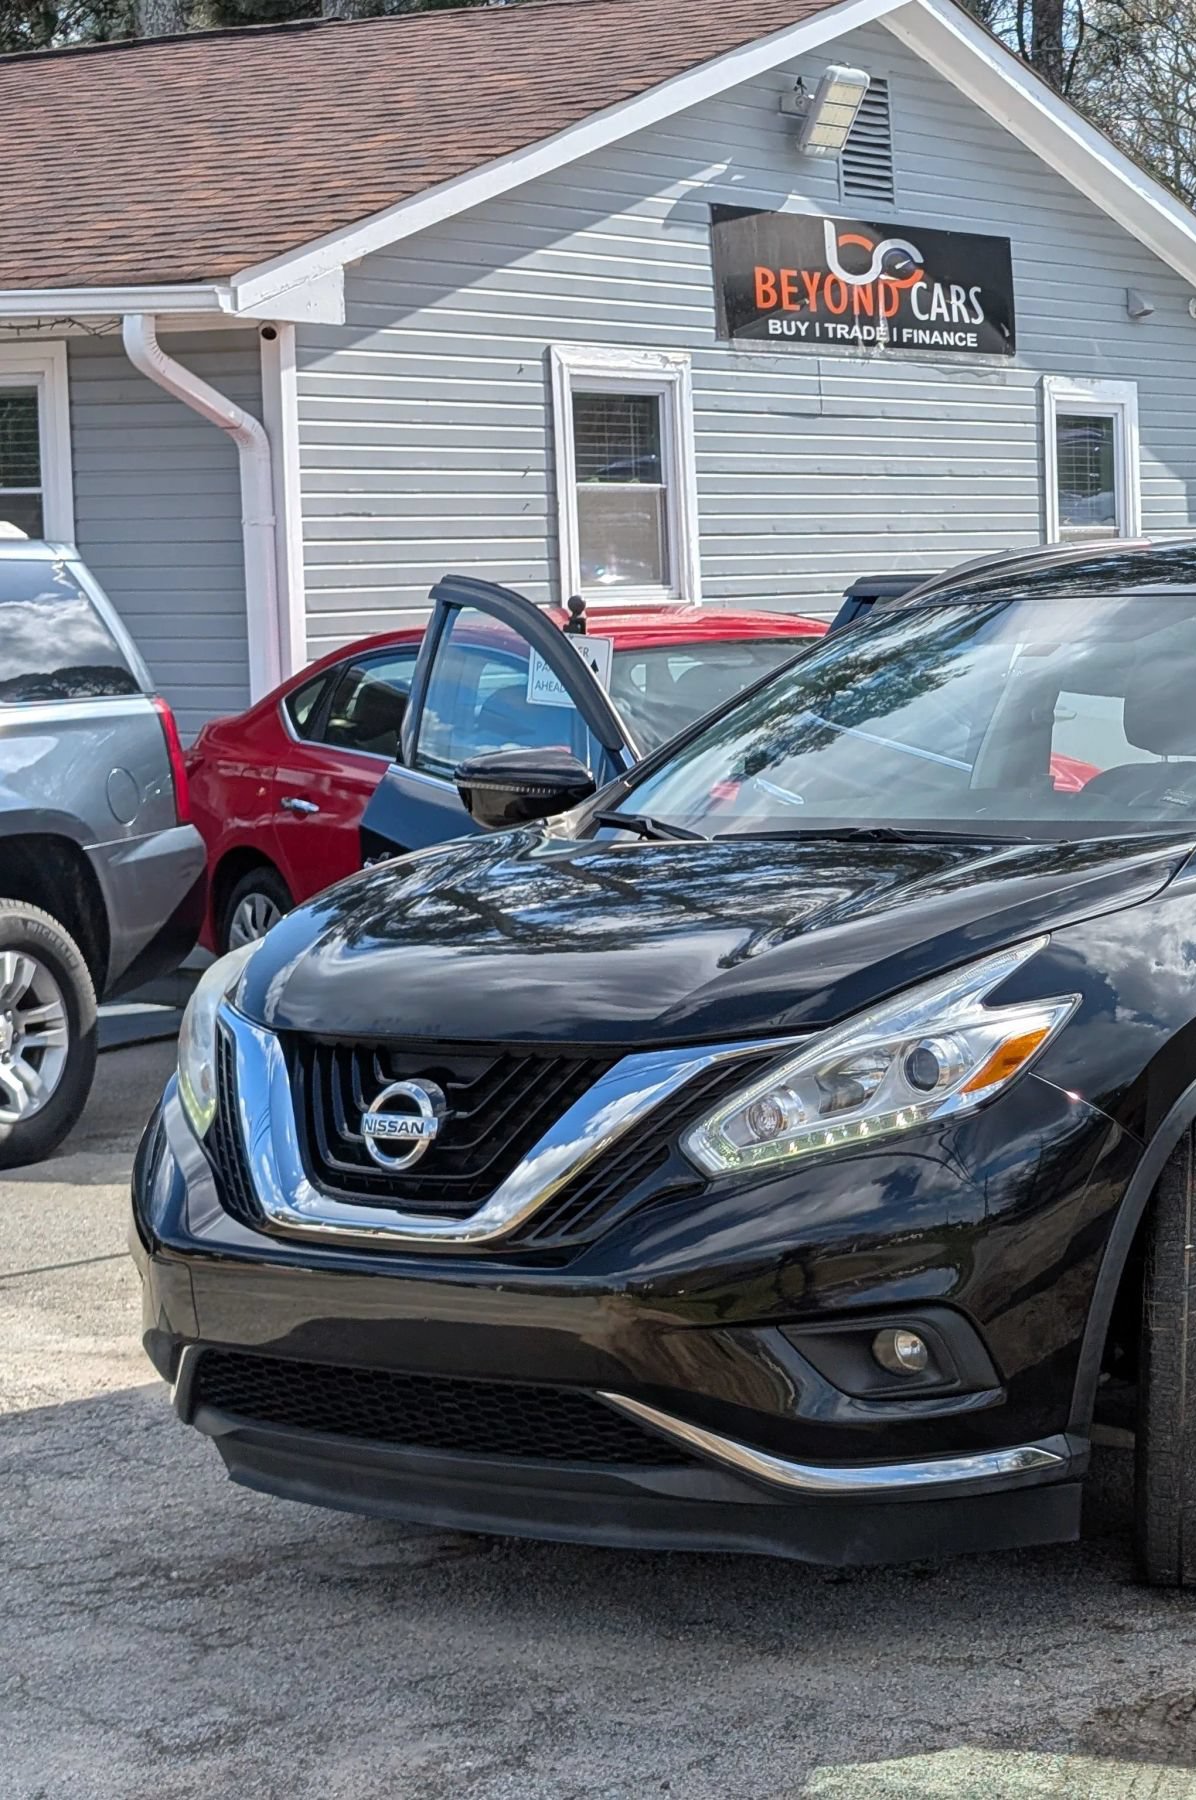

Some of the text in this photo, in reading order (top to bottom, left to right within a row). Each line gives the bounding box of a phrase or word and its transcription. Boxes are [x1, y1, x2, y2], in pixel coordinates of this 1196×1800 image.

[754, 266, 985, 325] BEYOND CARS
[768, 319, 810, 337] BUY
[824, 322, 887, 341] TRADE
[903, 328, 978, 347] FINANCE
[364, 1118, 425, 1134] NISSAN
